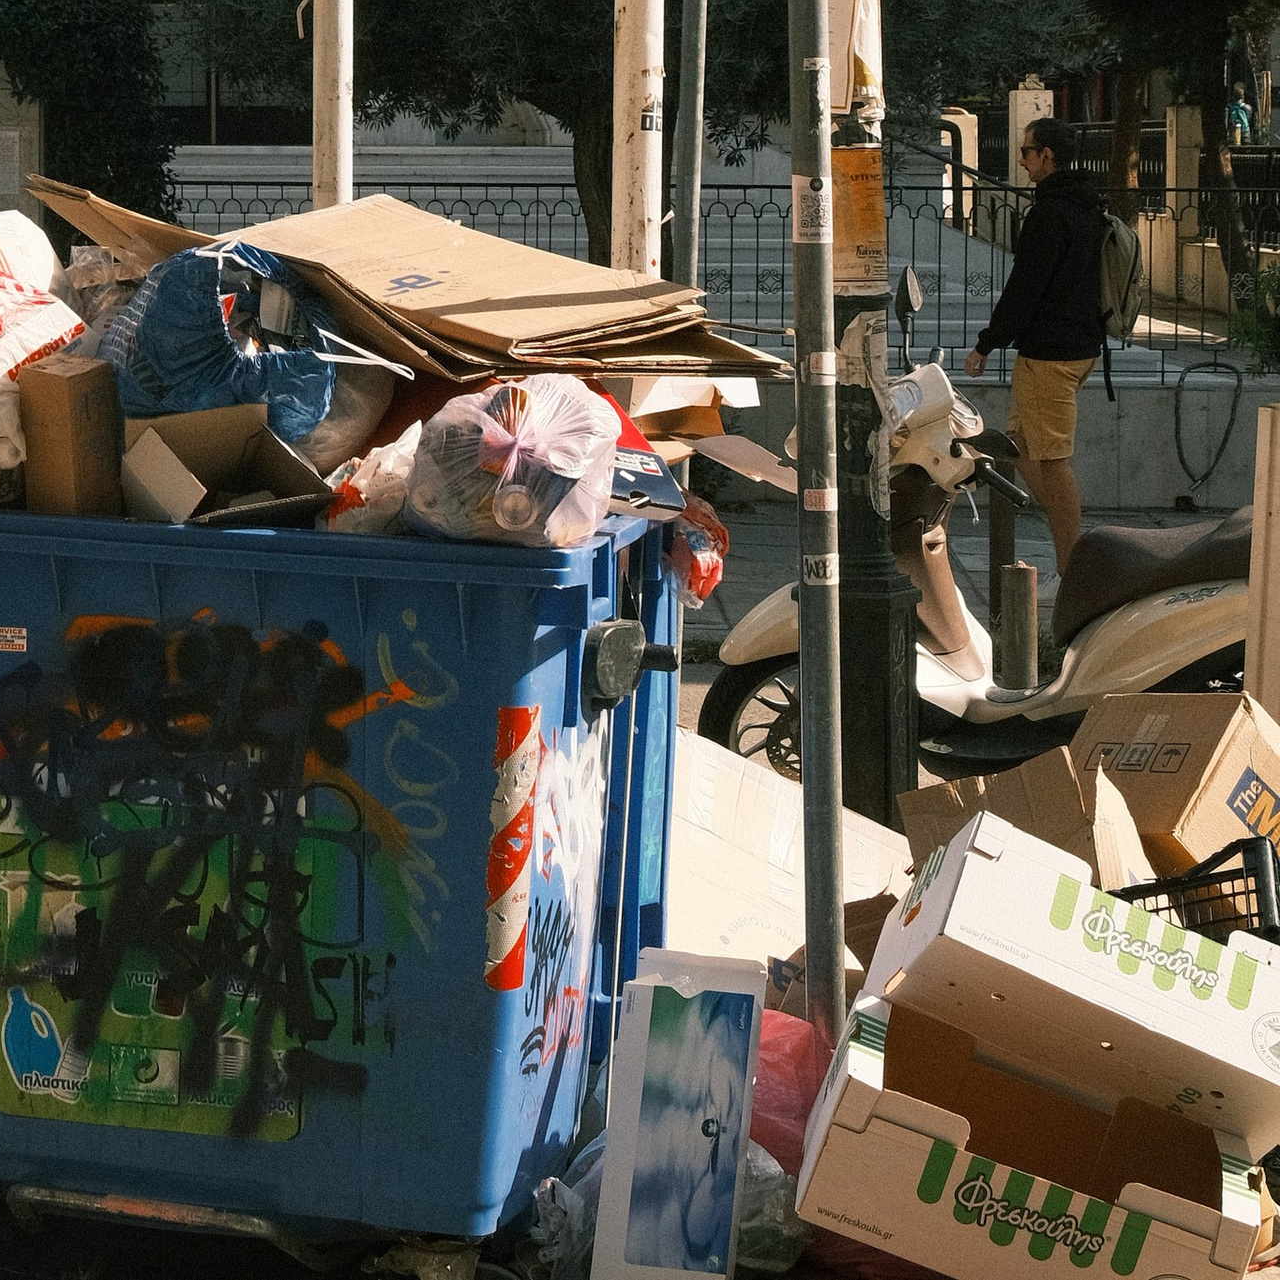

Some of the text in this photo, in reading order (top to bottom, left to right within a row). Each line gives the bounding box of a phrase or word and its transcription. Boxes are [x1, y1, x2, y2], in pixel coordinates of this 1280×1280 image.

[1233, 780, 1262, 814] The
[1082, 905, 1220, 989] Φρεσκούλης
[816, 1206, 895, 1240] www.freskoulis.gr
[955, 1174, 1106, 1255] Φρεσκούλης
